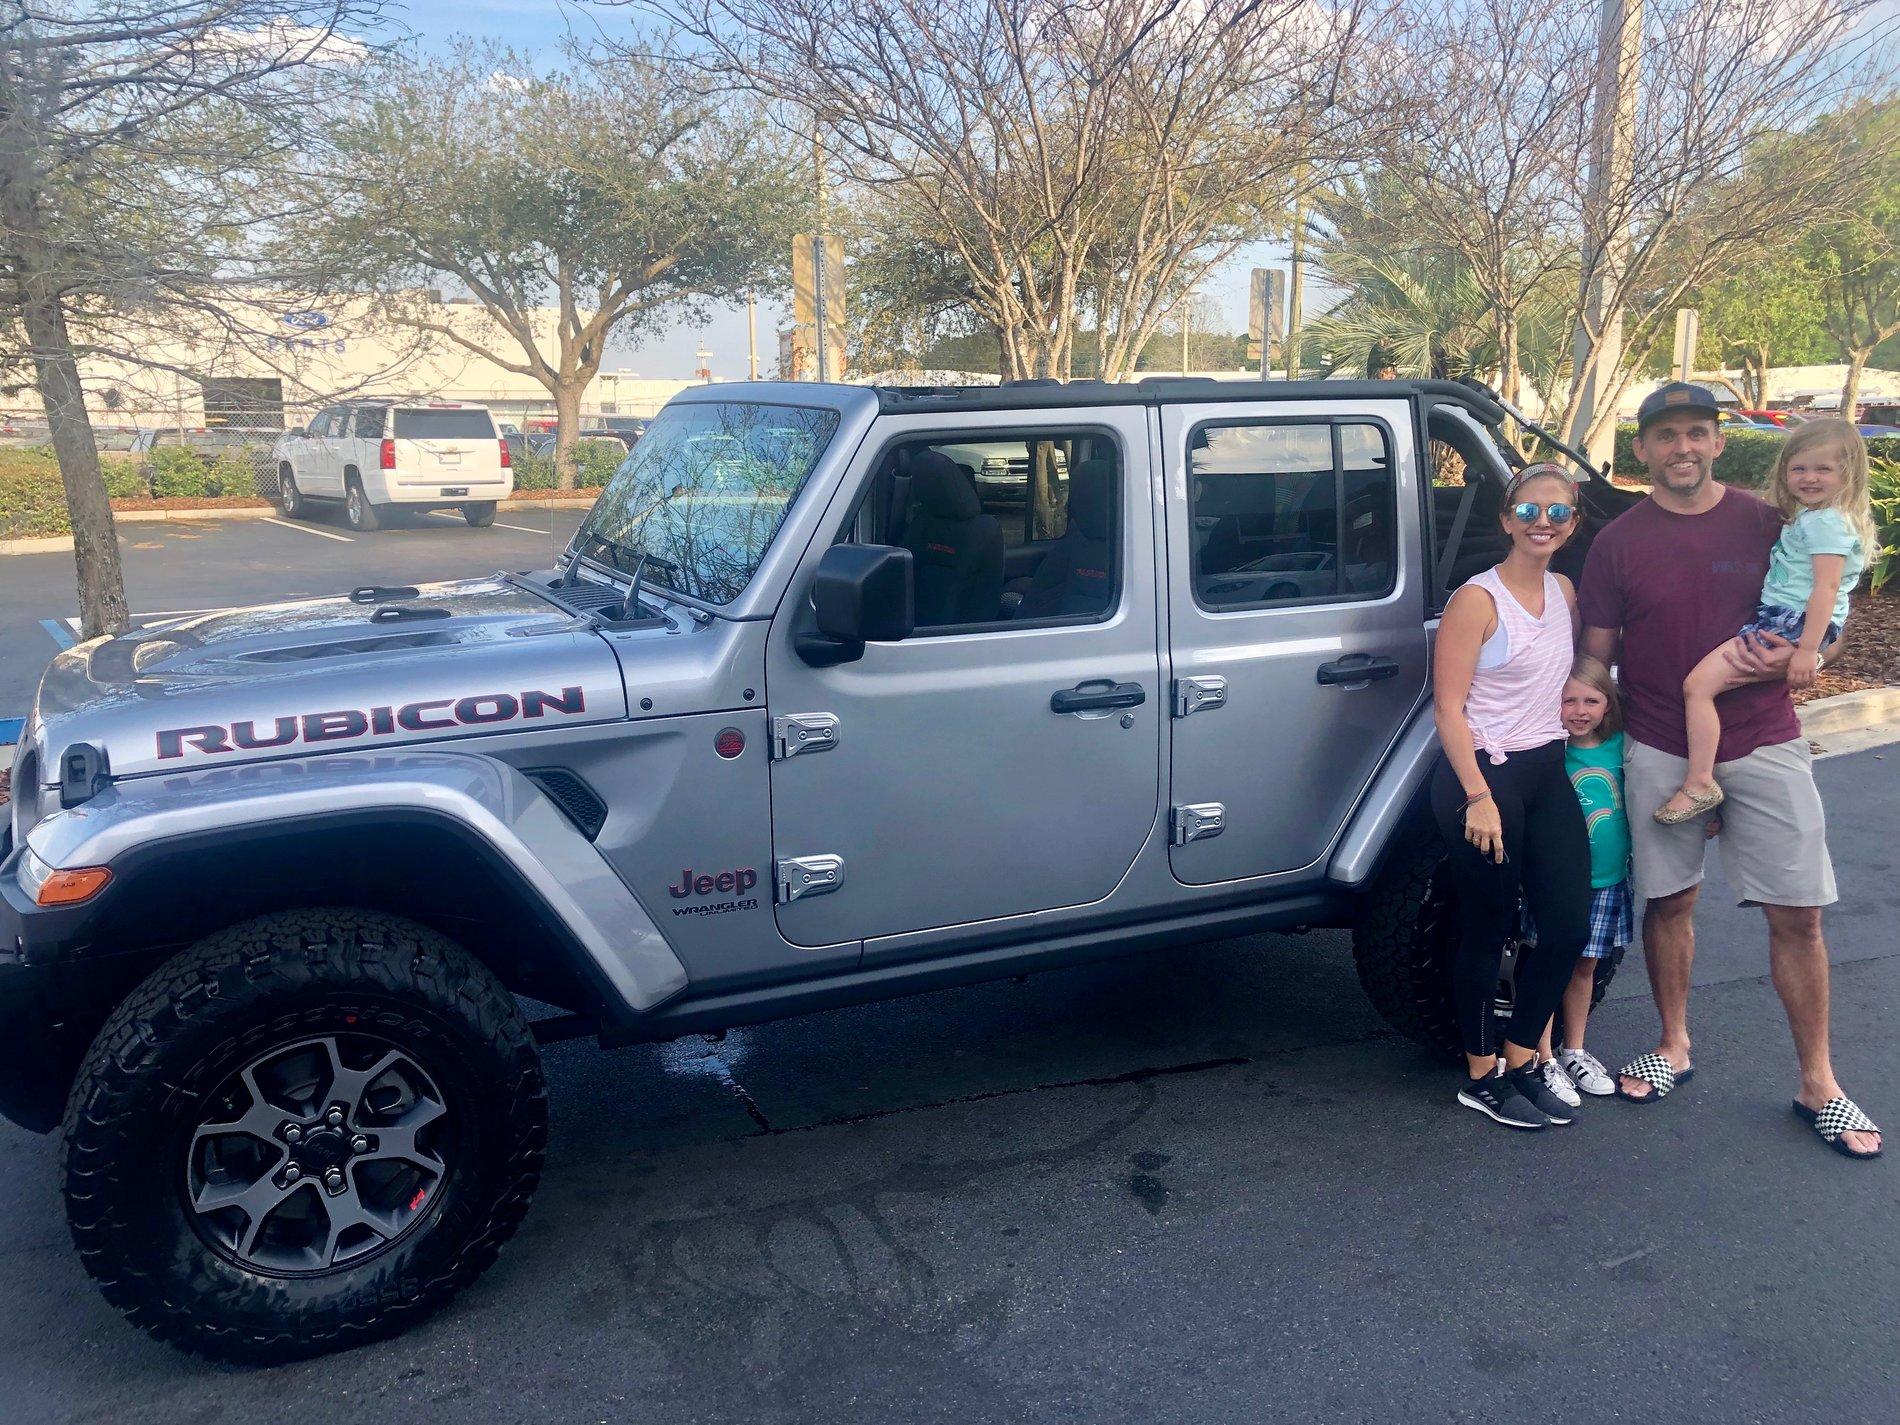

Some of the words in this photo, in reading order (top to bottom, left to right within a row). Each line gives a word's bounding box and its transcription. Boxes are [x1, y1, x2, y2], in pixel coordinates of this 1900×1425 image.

[155, 686, 586, 759] RUBICON
[668, 867, 758, 899] Jeep
[672, 898, 758, 916] WRANGLER
[700, 904, 758, 917] UNLIMITED
